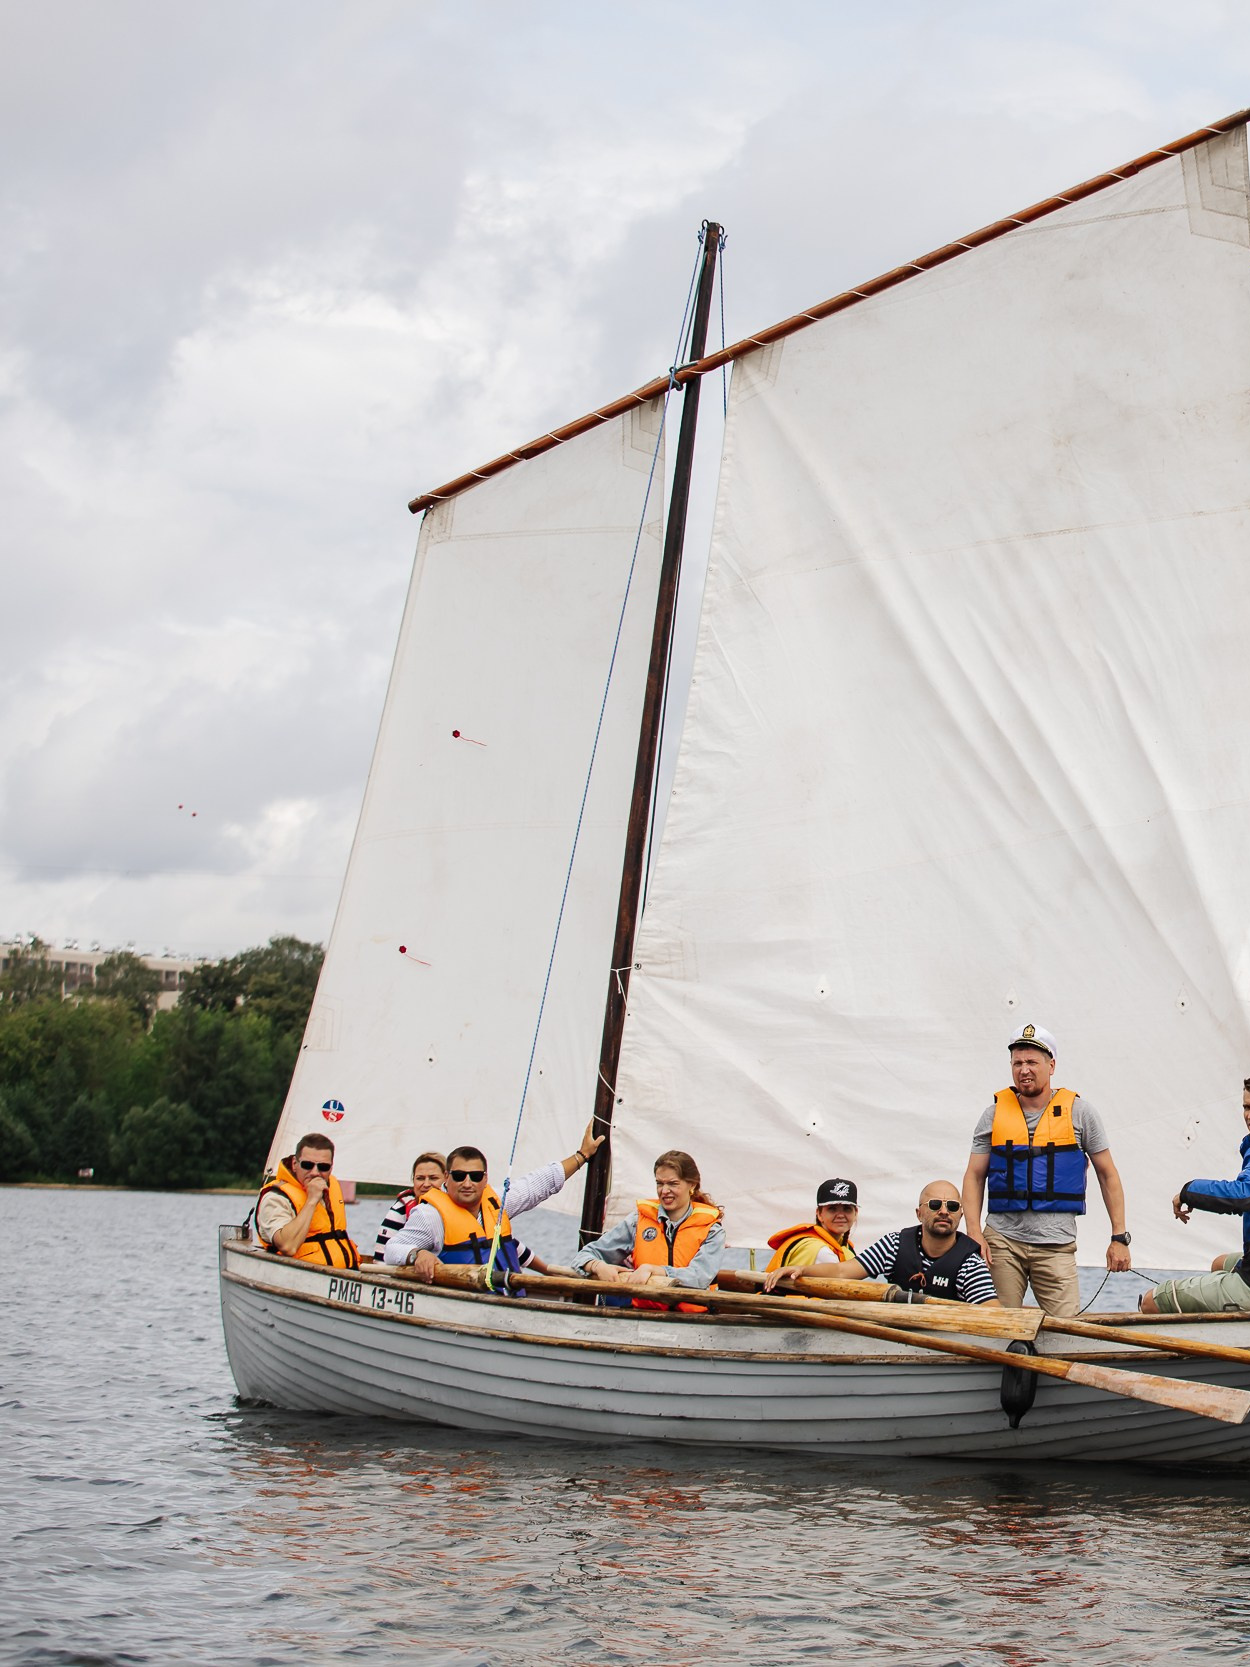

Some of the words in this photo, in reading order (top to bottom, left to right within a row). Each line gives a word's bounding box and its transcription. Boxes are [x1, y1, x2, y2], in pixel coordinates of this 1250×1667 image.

[932, 1275, 949, 1288] HH
[328, 1278, 362, 1304] РМЮ
[371, 1287, 414, 1314] 13-46
